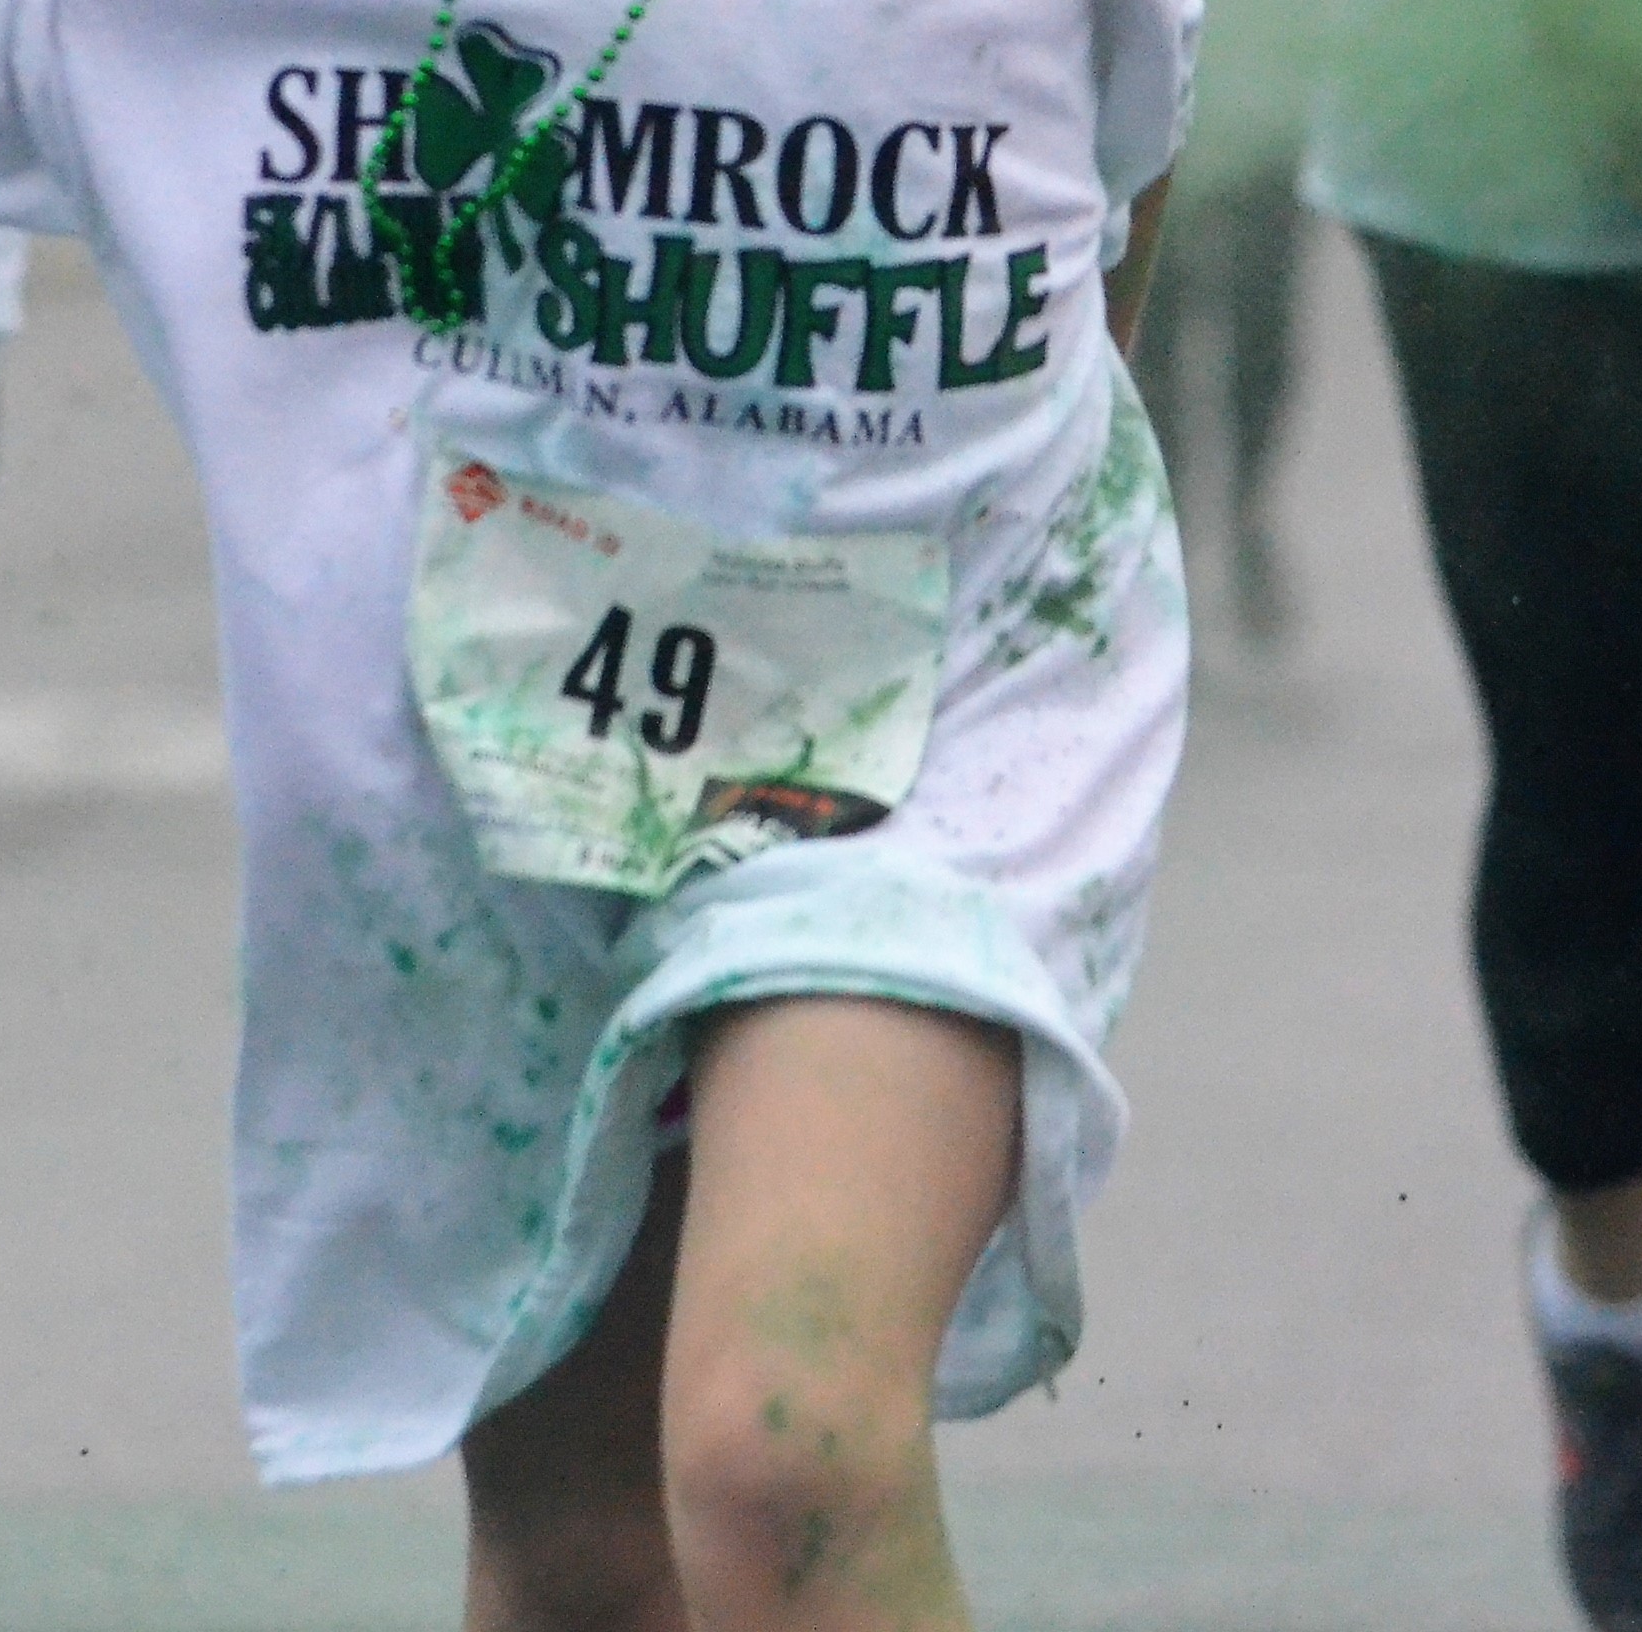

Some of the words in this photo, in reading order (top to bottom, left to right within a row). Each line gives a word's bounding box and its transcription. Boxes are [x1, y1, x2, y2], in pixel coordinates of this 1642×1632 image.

[259, 58, 1011, 243] SHMROCK
[411, 328, 637, 426] CULLMN,
[657, 388, 927, 447] ALABAMA
[535, 218, 1051, 394] SHUFFLE
[561, 604, 718, 756] 49
